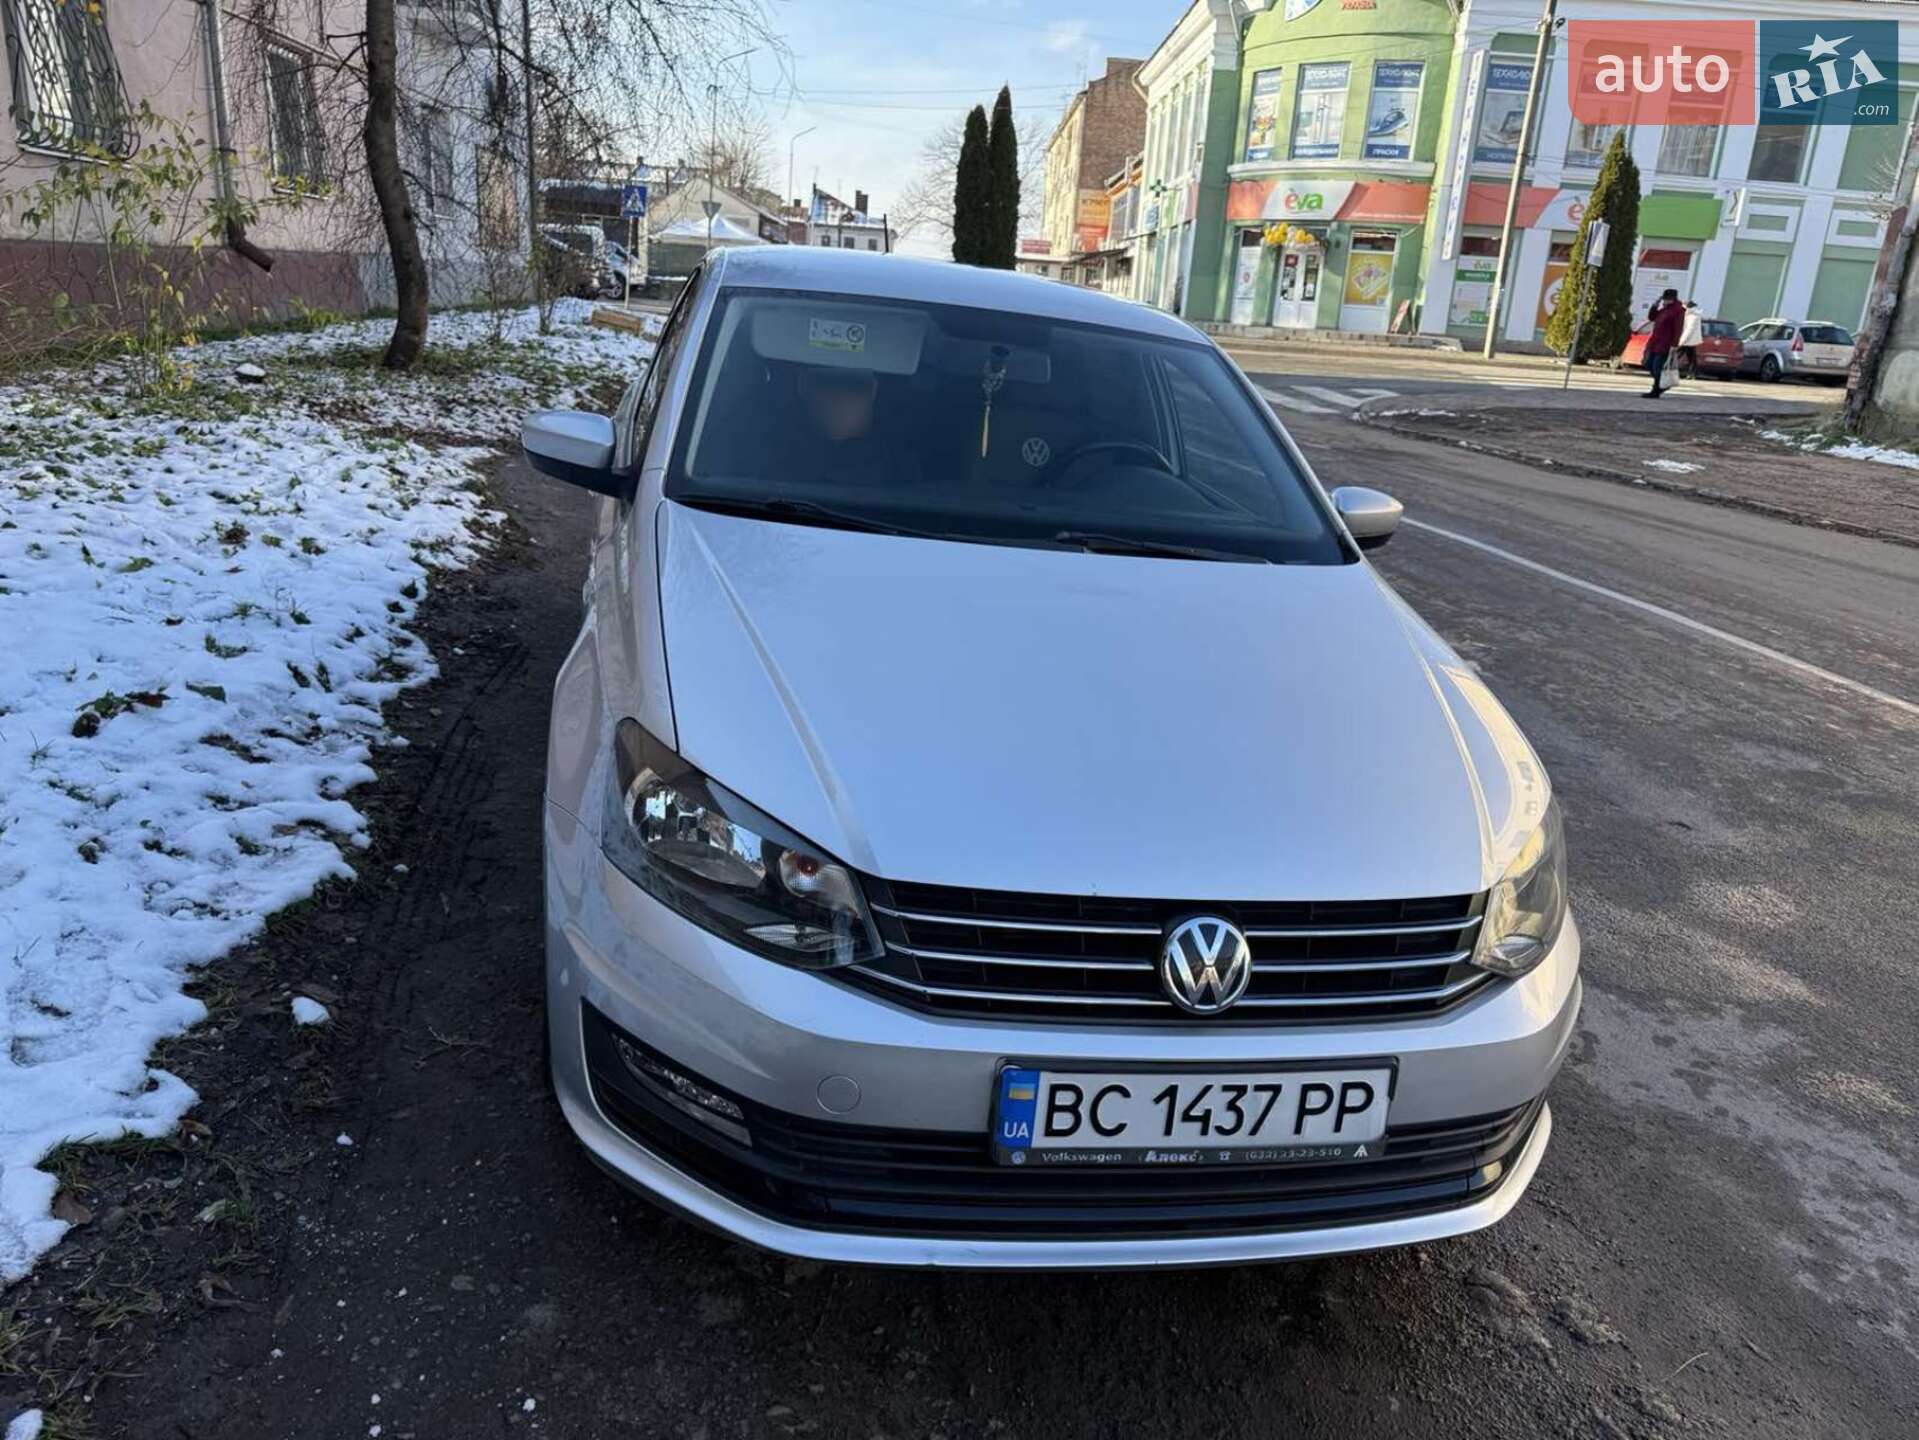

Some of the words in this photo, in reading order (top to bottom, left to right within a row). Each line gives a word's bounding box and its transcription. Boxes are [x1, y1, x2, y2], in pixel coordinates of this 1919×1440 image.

[1044, 1083, 1132, 1137] BC
[1153, 1083, 1283, 1137] 1437
[1294, 1081, 1375, 1135] PP
[1003, 1122, 1030, 1139] UA
[1042, 1151, 1122, 1164] Volkswagen
